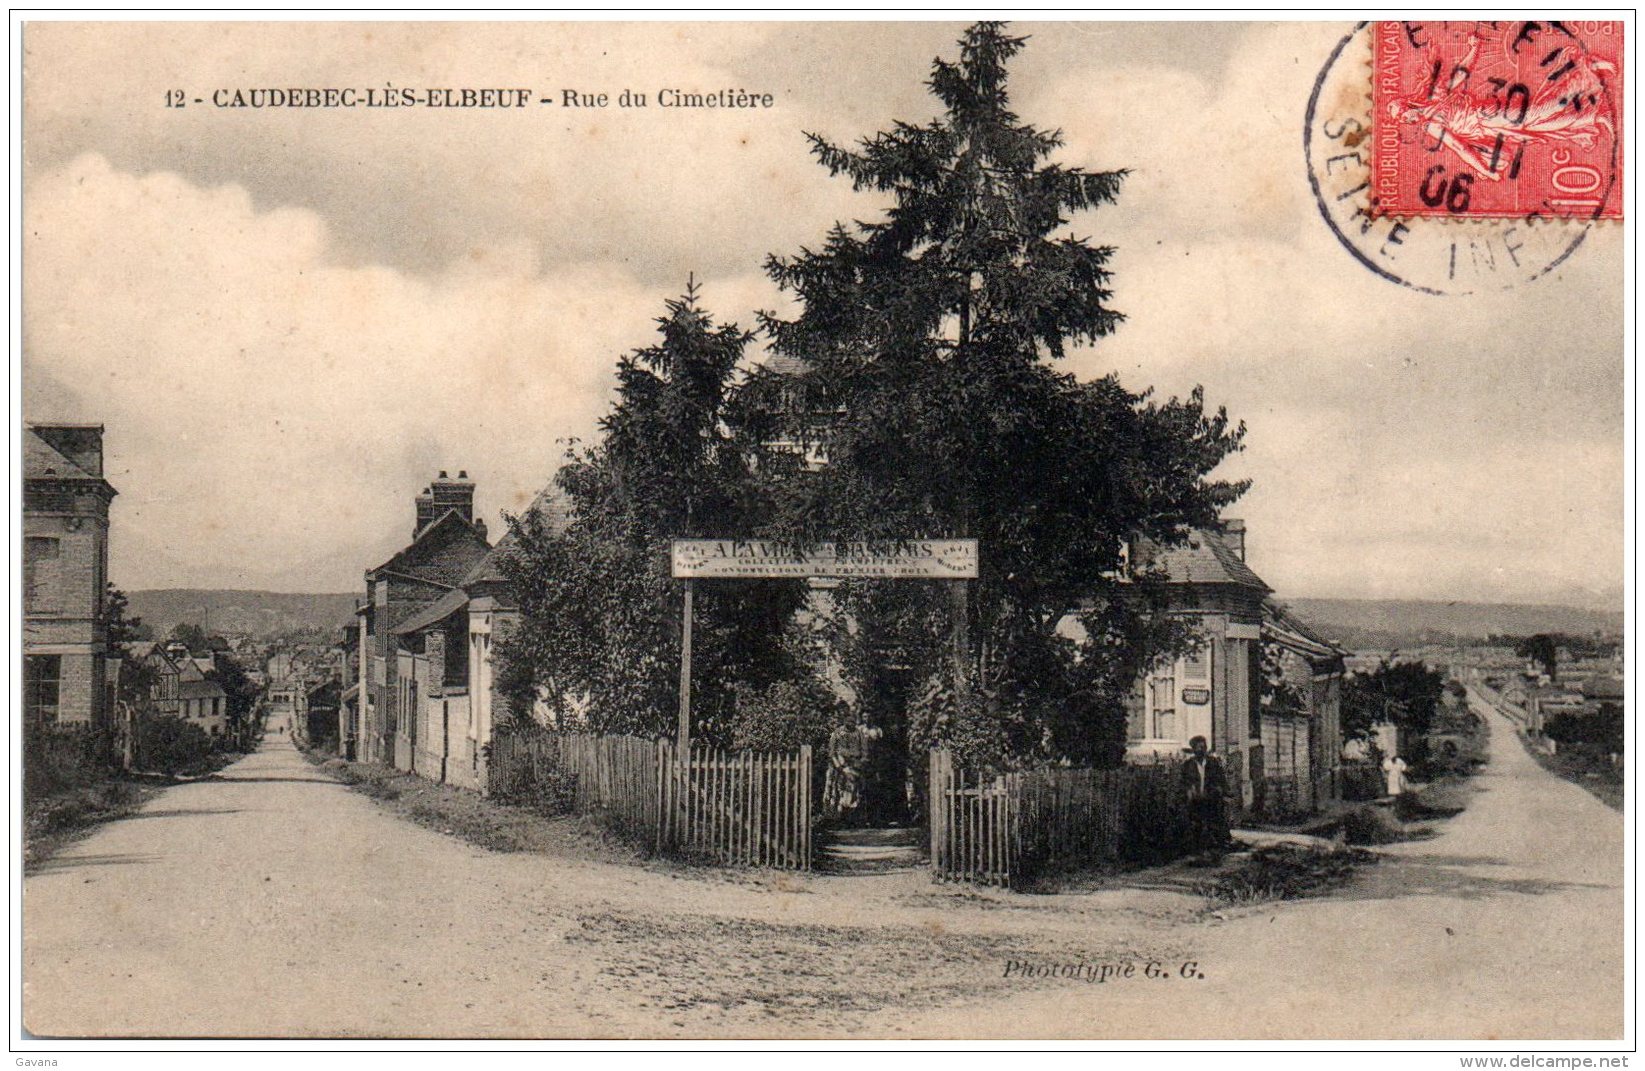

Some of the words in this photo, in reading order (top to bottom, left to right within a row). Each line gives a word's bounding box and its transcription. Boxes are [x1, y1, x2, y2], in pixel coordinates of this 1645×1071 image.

[164, 89, 186, 108] 12
[212, 82, 532, 108] CAUDEBEC-LÈS-ELBEUF
[562, 88, 609, 108] Rue
[618, 88, 647, 108] du
[657, 88, 774, 108] Cimetière
[1002, 959, 1136, 984] Phototypie
[1144, 960, 1170, 980] G.
[1179, 960, 1206, 980] G.
